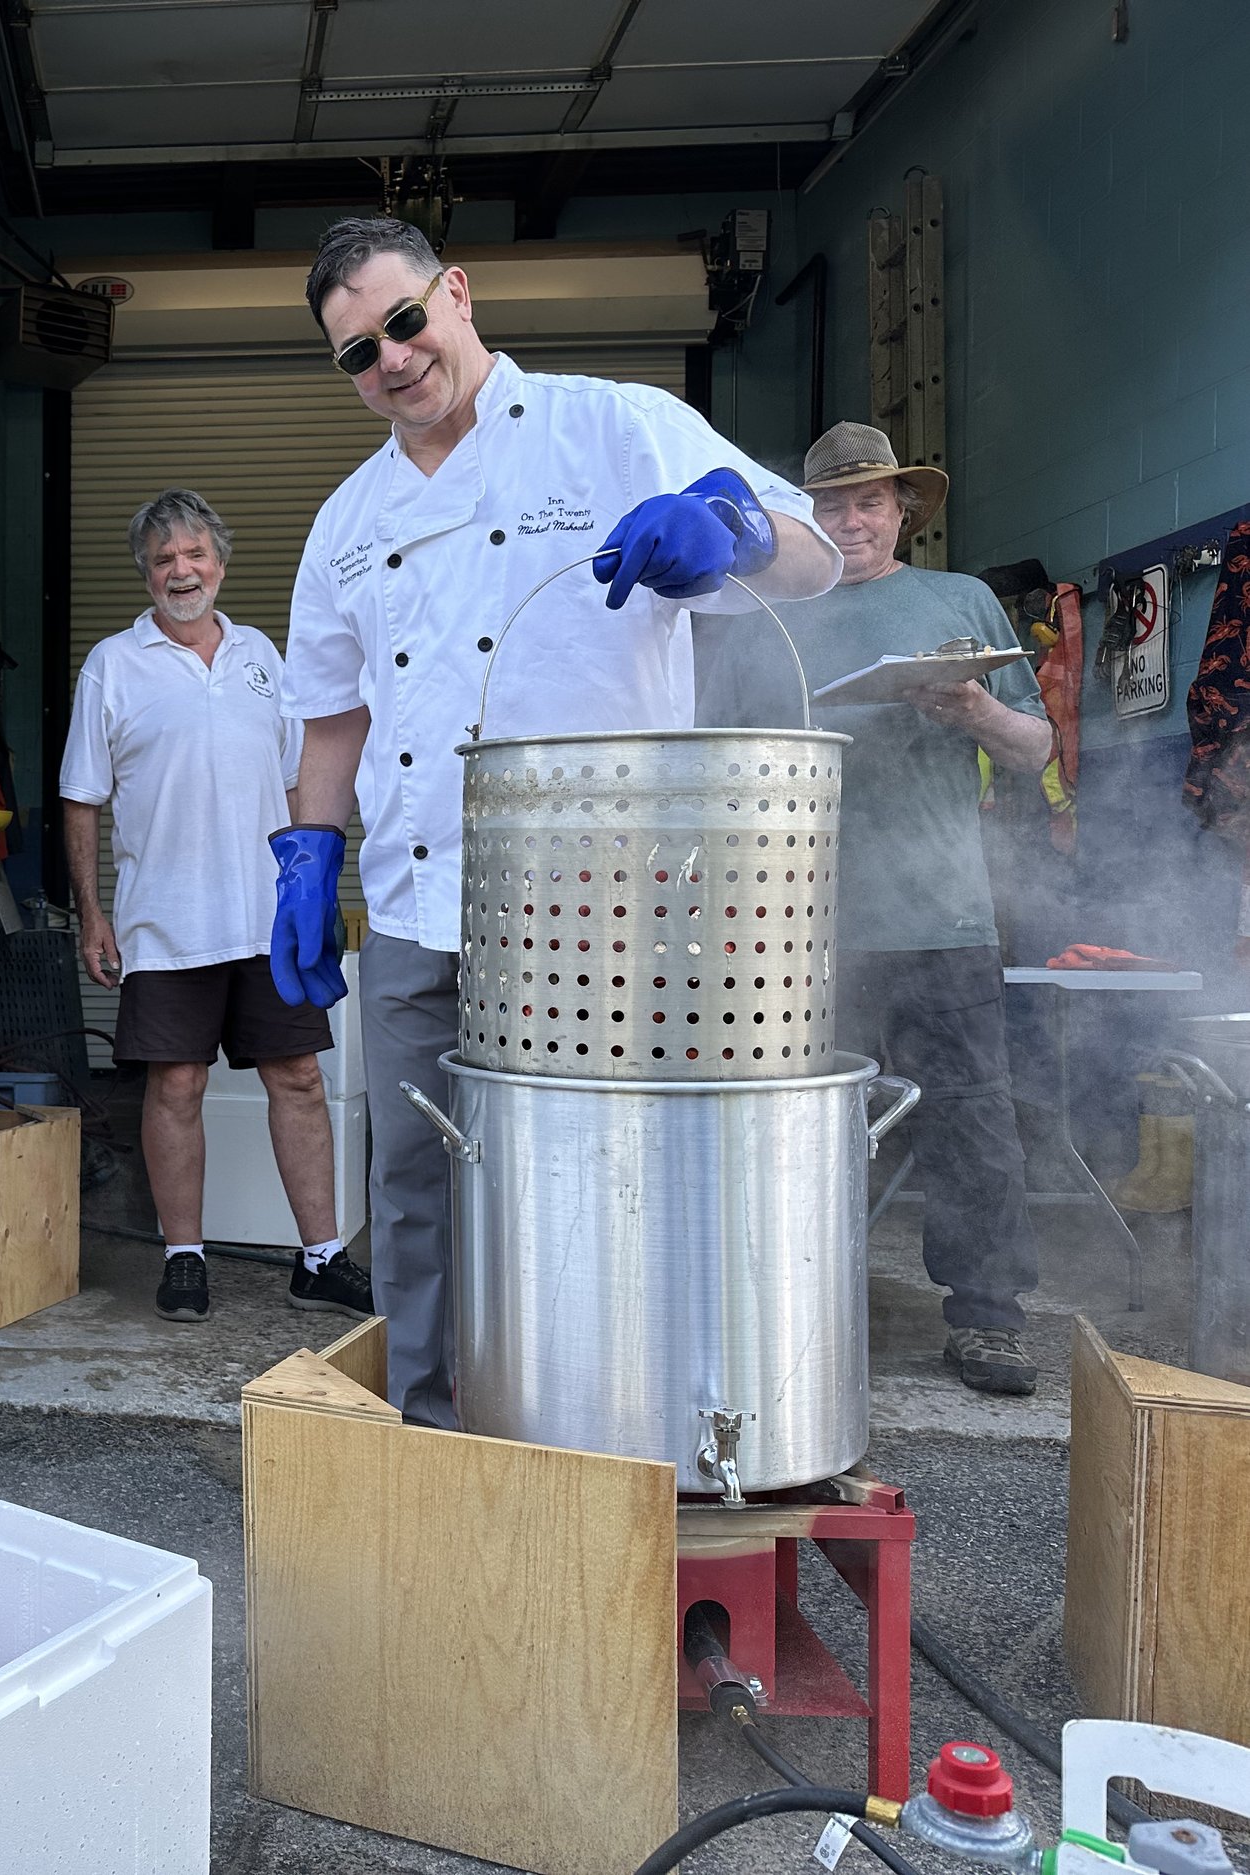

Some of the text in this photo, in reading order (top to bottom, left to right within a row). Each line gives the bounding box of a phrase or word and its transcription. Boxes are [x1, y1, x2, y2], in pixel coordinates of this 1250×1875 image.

[547, 496, 565, 506] Inn
[520, 507, 592, 522] On The Twenty
[1131, 654, 1146, 675] NO
[1116, 673, 1163, 703] PARKING
